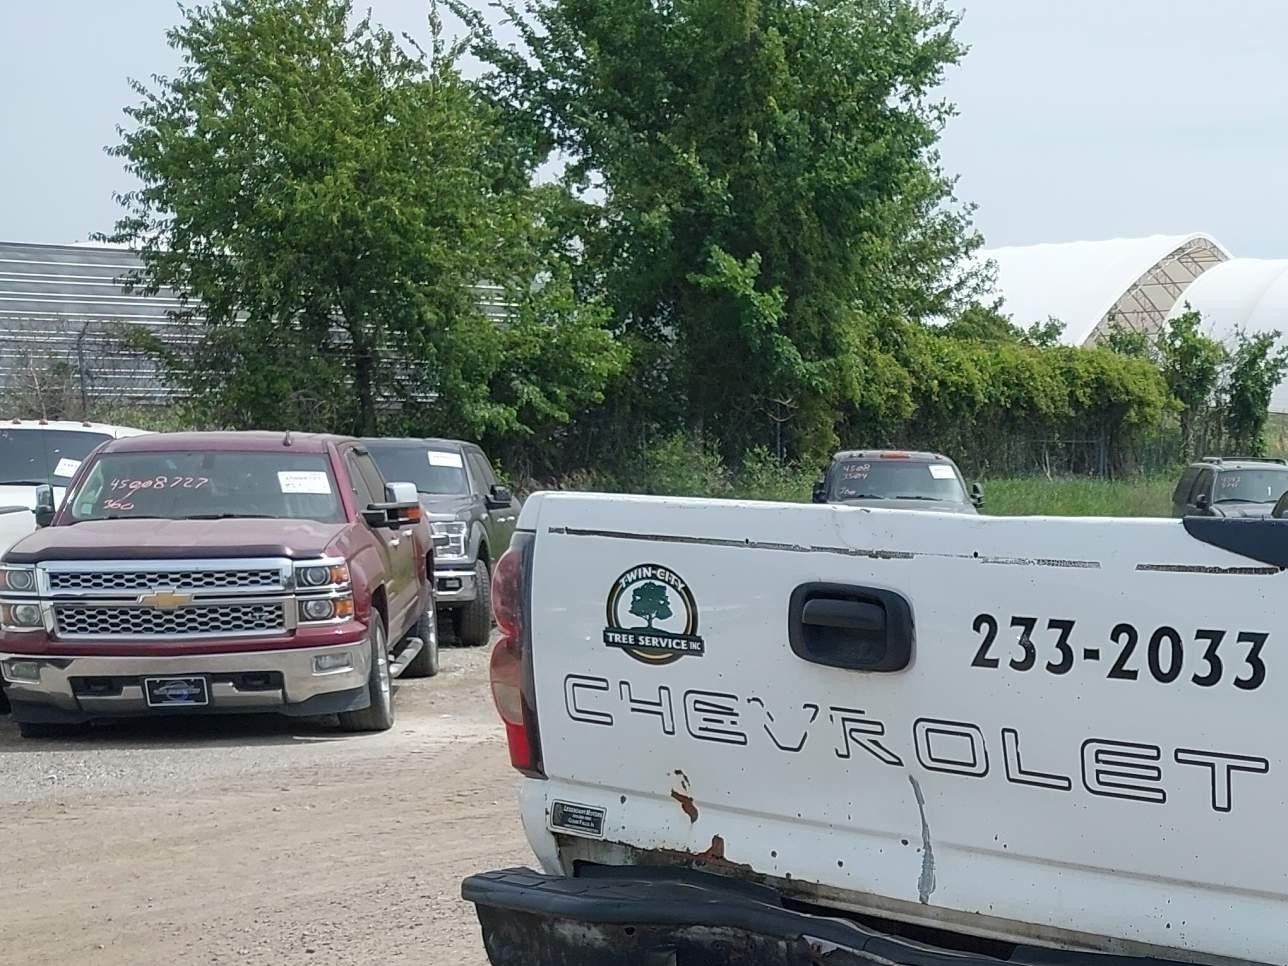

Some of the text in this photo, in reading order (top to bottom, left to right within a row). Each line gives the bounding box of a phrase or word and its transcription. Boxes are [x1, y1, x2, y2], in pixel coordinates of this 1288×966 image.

[620, 566, 685, 591] TWIN-CITY
[607, 632, 635, 645] TREE
[638, 635, 688, 650] SERVICE
[970, 613, 1270, 691] 233-2033
[563, 673, 1270, 813] CHEVROLET
